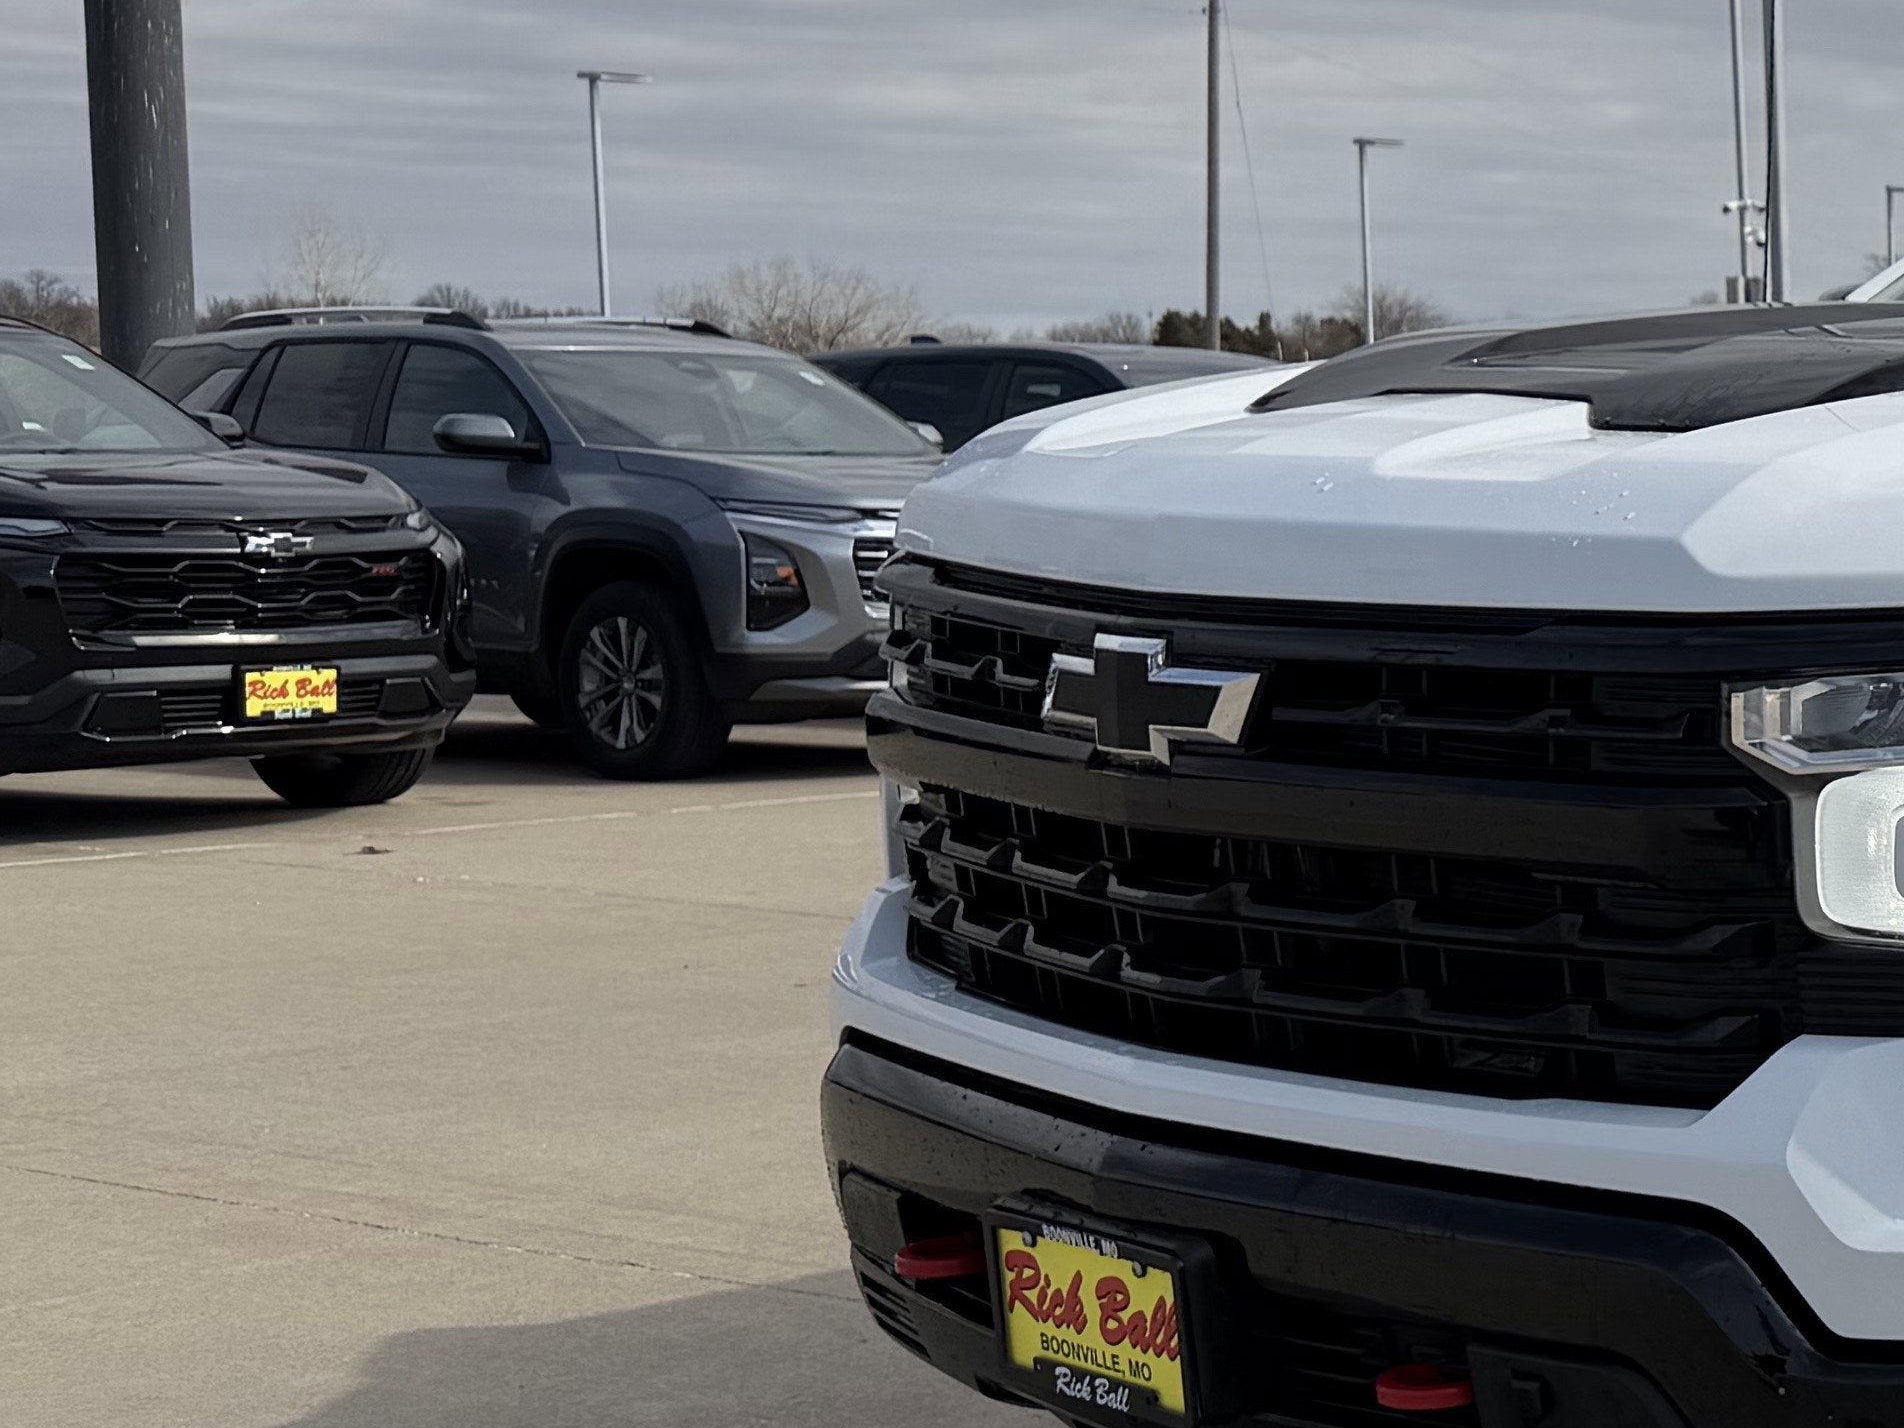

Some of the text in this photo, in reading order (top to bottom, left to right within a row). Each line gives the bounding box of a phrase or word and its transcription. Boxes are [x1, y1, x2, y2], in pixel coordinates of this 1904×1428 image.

[1100, 1239, 1119, 1259] MO
[1005, 1249, 1181, 1361] Rick Ball
[1040, 1332, 1152, 1382] BOONVILLE, MO
[1054, 1366, 1131, 1413] Rick Ball
